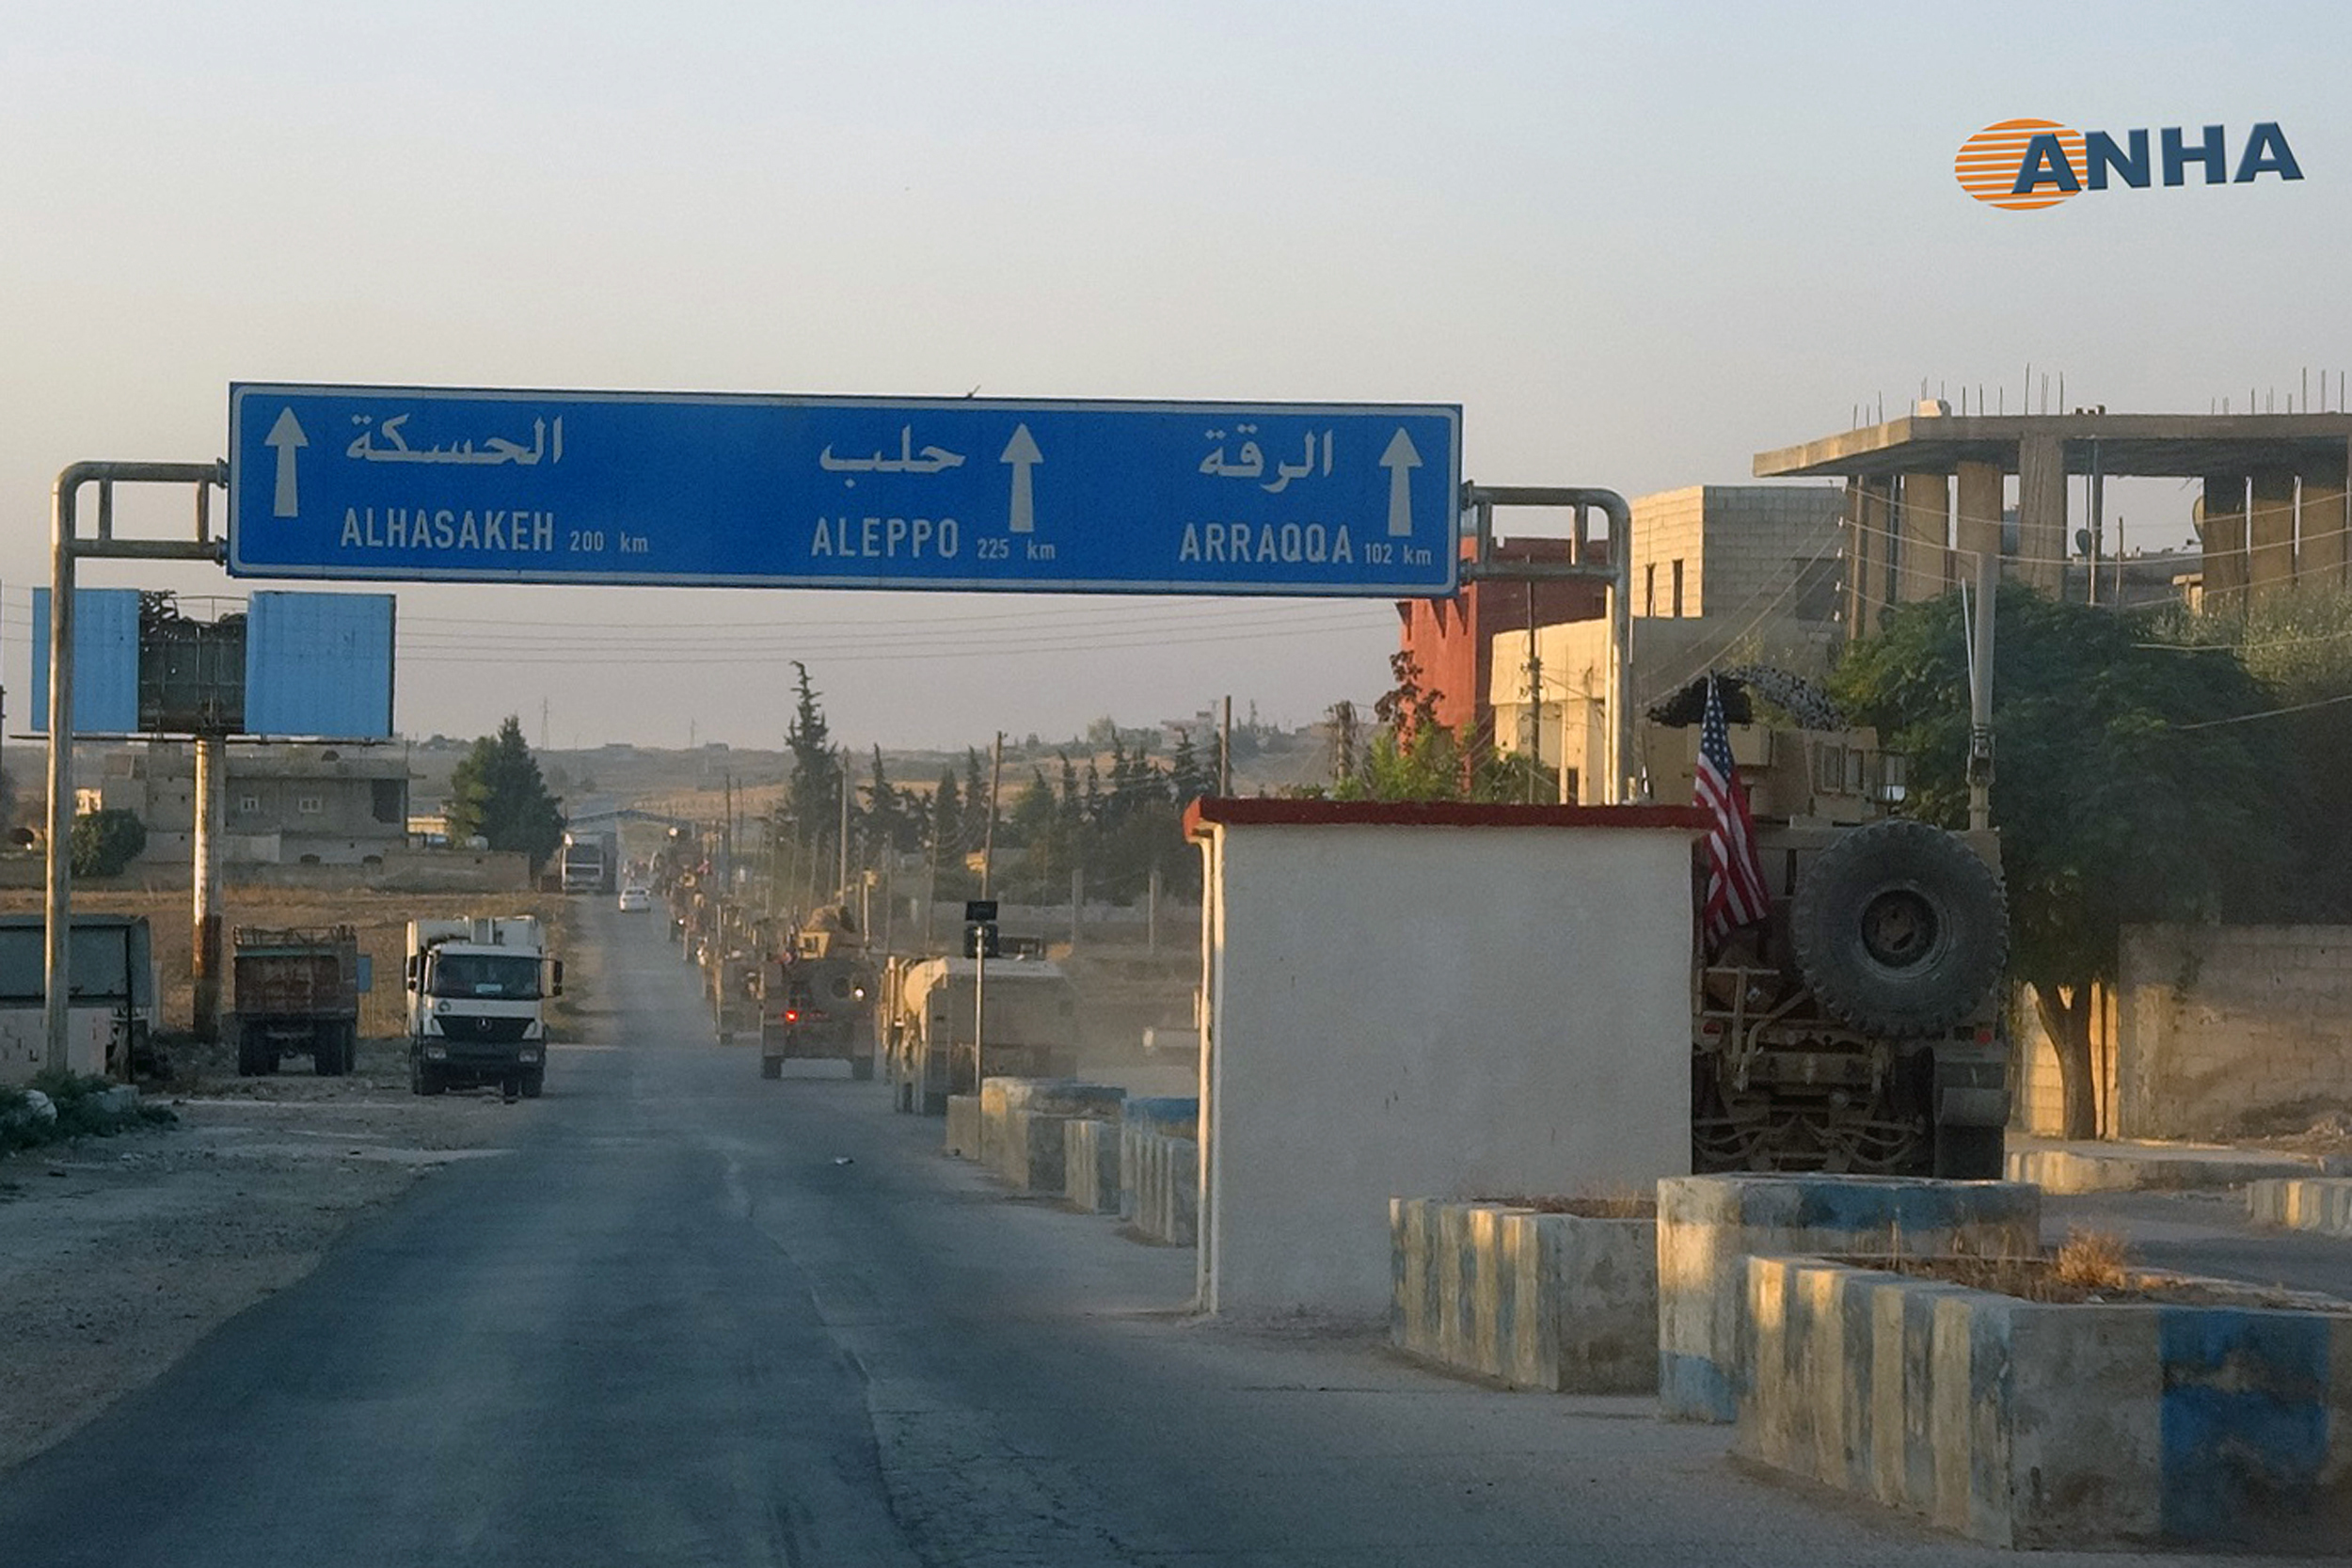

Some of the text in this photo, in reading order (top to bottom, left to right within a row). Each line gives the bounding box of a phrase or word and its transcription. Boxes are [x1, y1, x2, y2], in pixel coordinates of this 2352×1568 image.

[346, 413, 564, 465] الحسكة
[819, 424, 965, 487] حلب
[1199, 424, 1333, 492] الرقة
[341, 508, 649, 553] ALHASAKEH 200 km
[812, 517, 1056, 560] ALEPPO 225 km
[1180, 523, 1433, 566] ARRAQQA 102 km
